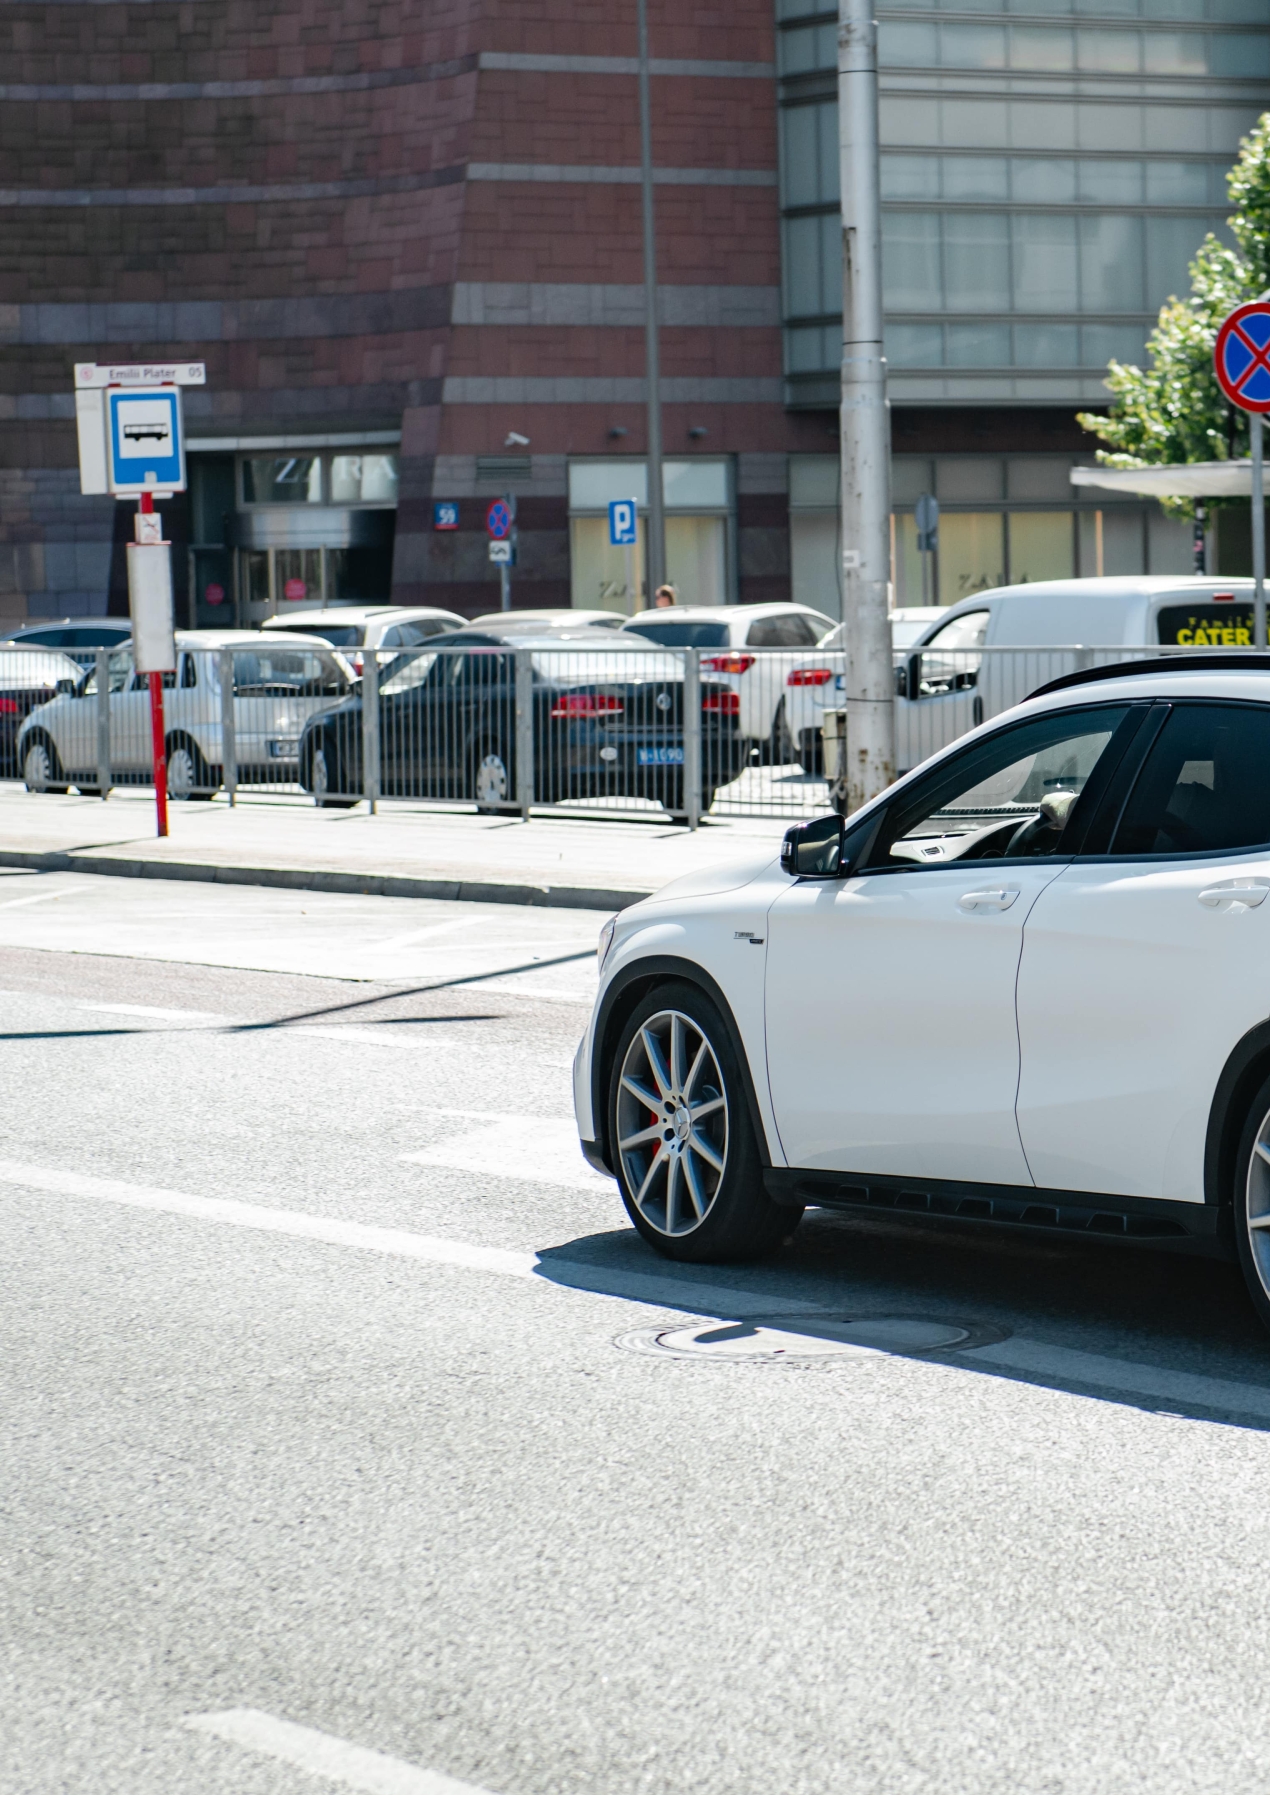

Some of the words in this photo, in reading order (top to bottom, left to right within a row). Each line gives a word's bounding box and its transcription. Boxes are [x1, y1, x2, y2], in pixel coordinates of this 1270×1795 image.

[109, 368, 139, 379] Emilii
[143, 367, 176, 378] Plater
[188, 366, 202, 377] 05
[614, 504, 631, 540] P
